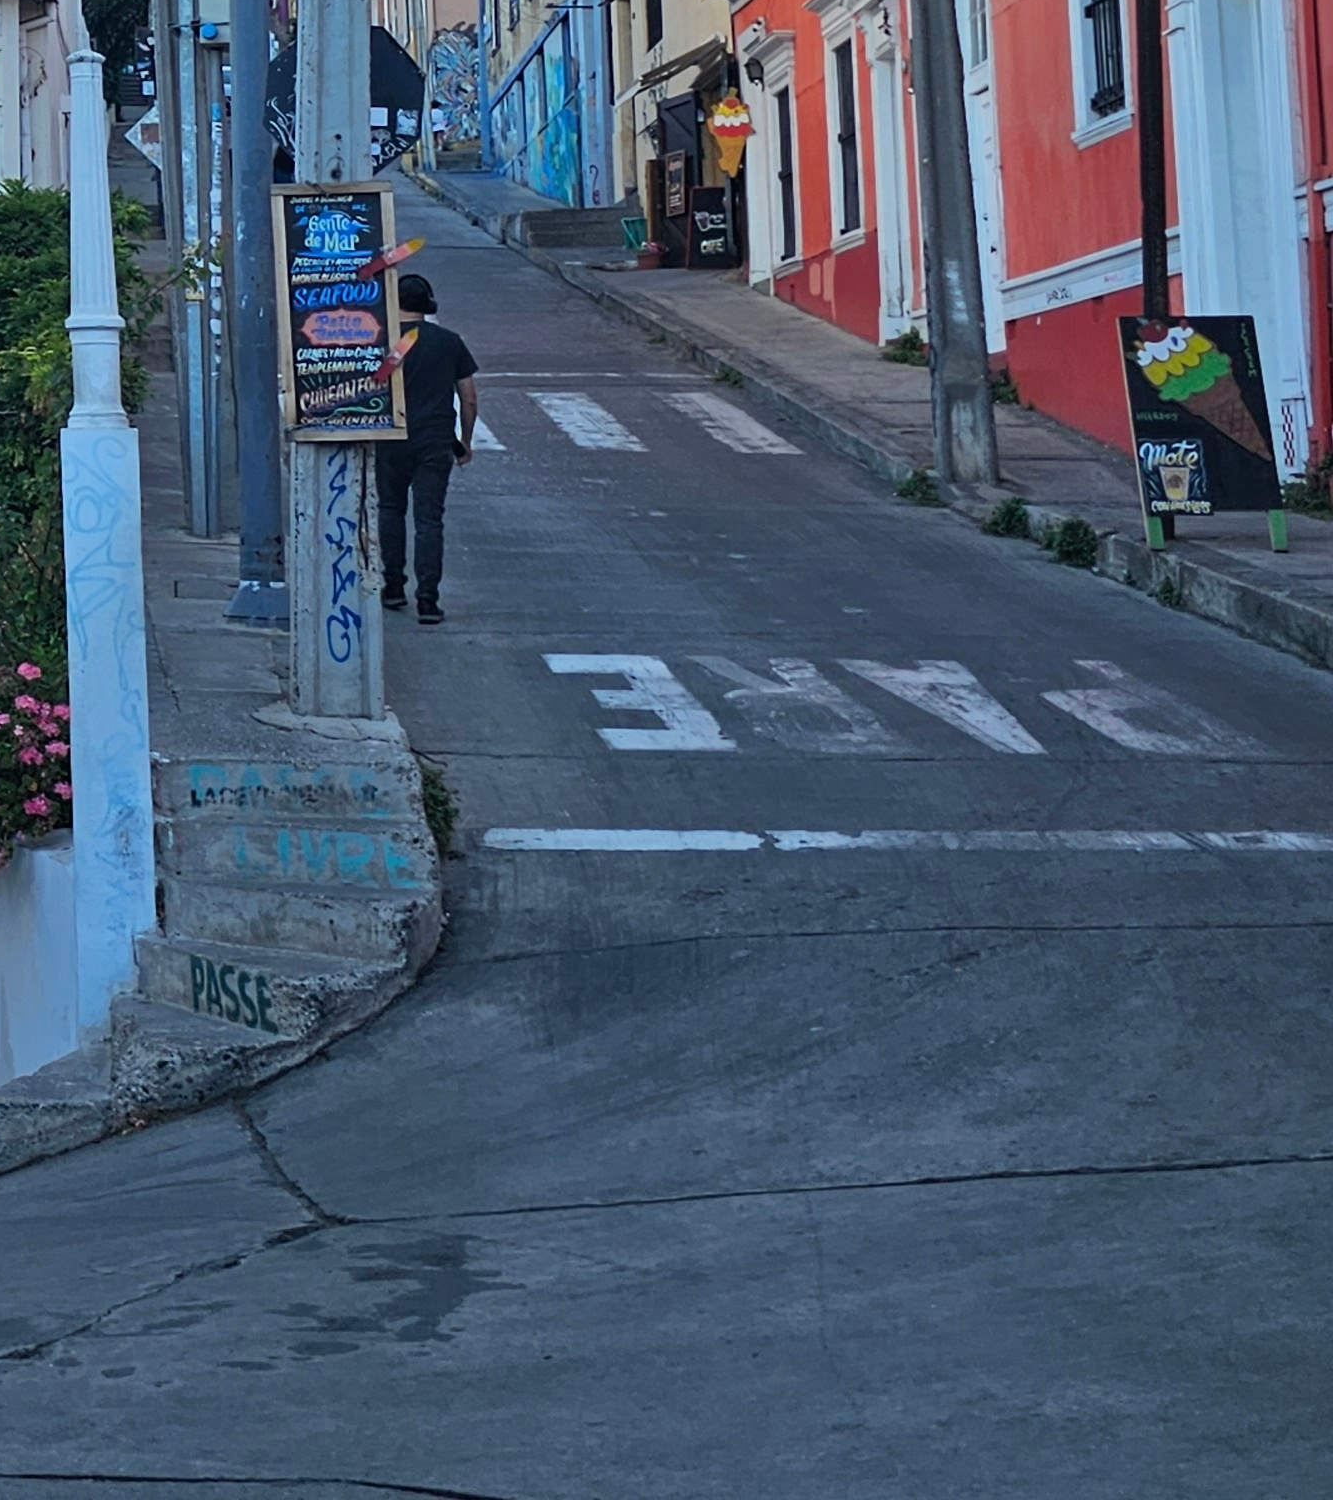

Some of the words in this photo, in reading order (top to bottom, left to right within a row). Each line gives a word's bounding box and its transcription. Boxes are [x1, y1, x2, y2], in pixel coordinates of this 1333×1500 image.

[304, 233, 321, 248] de
[324, 231, 359, 253] Mar
[294, 281, 379, 309] SEAFOOD
[295, 360, 355, 376] TEMPLEMAN
[189, 953, 279, 1034] PASSE
